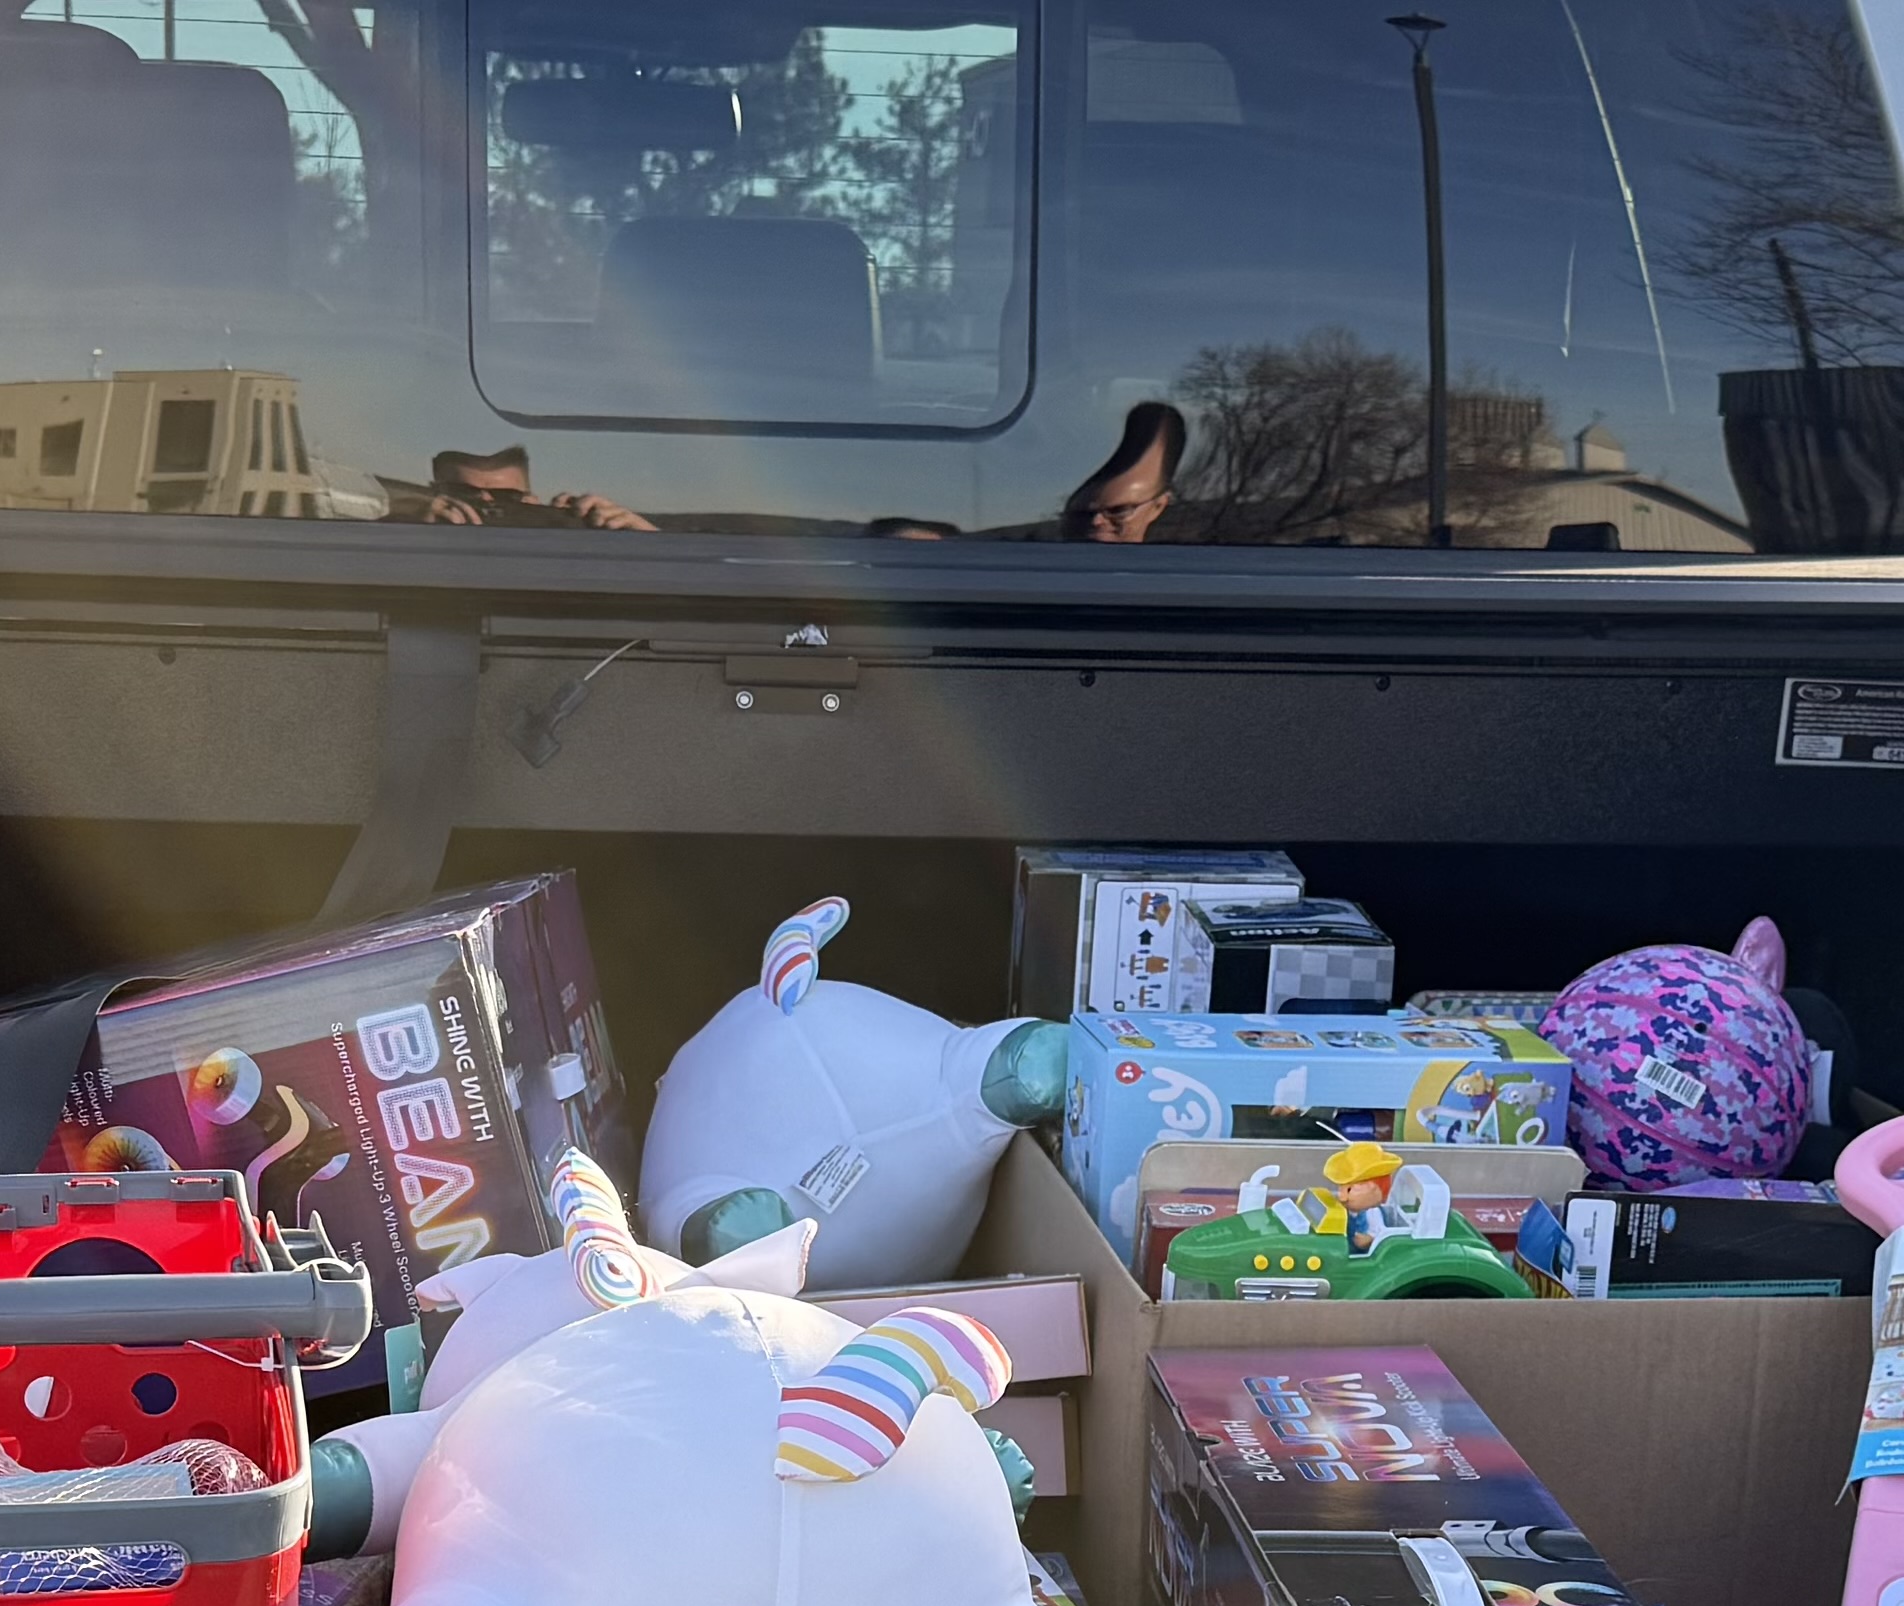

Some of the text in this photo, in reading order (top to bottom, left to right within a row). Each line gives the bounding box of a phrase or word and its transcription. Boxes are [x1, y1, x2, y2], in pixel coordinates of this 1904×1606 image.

[439, 995, 495, 1142] SHINE WITH
[330, 1021, 402, 1254] Supercharged Light-Up Wheel
[1241, 1375, 1360, 1483] SUPER
[1299, 1372, 1441, 1482] NOVA
